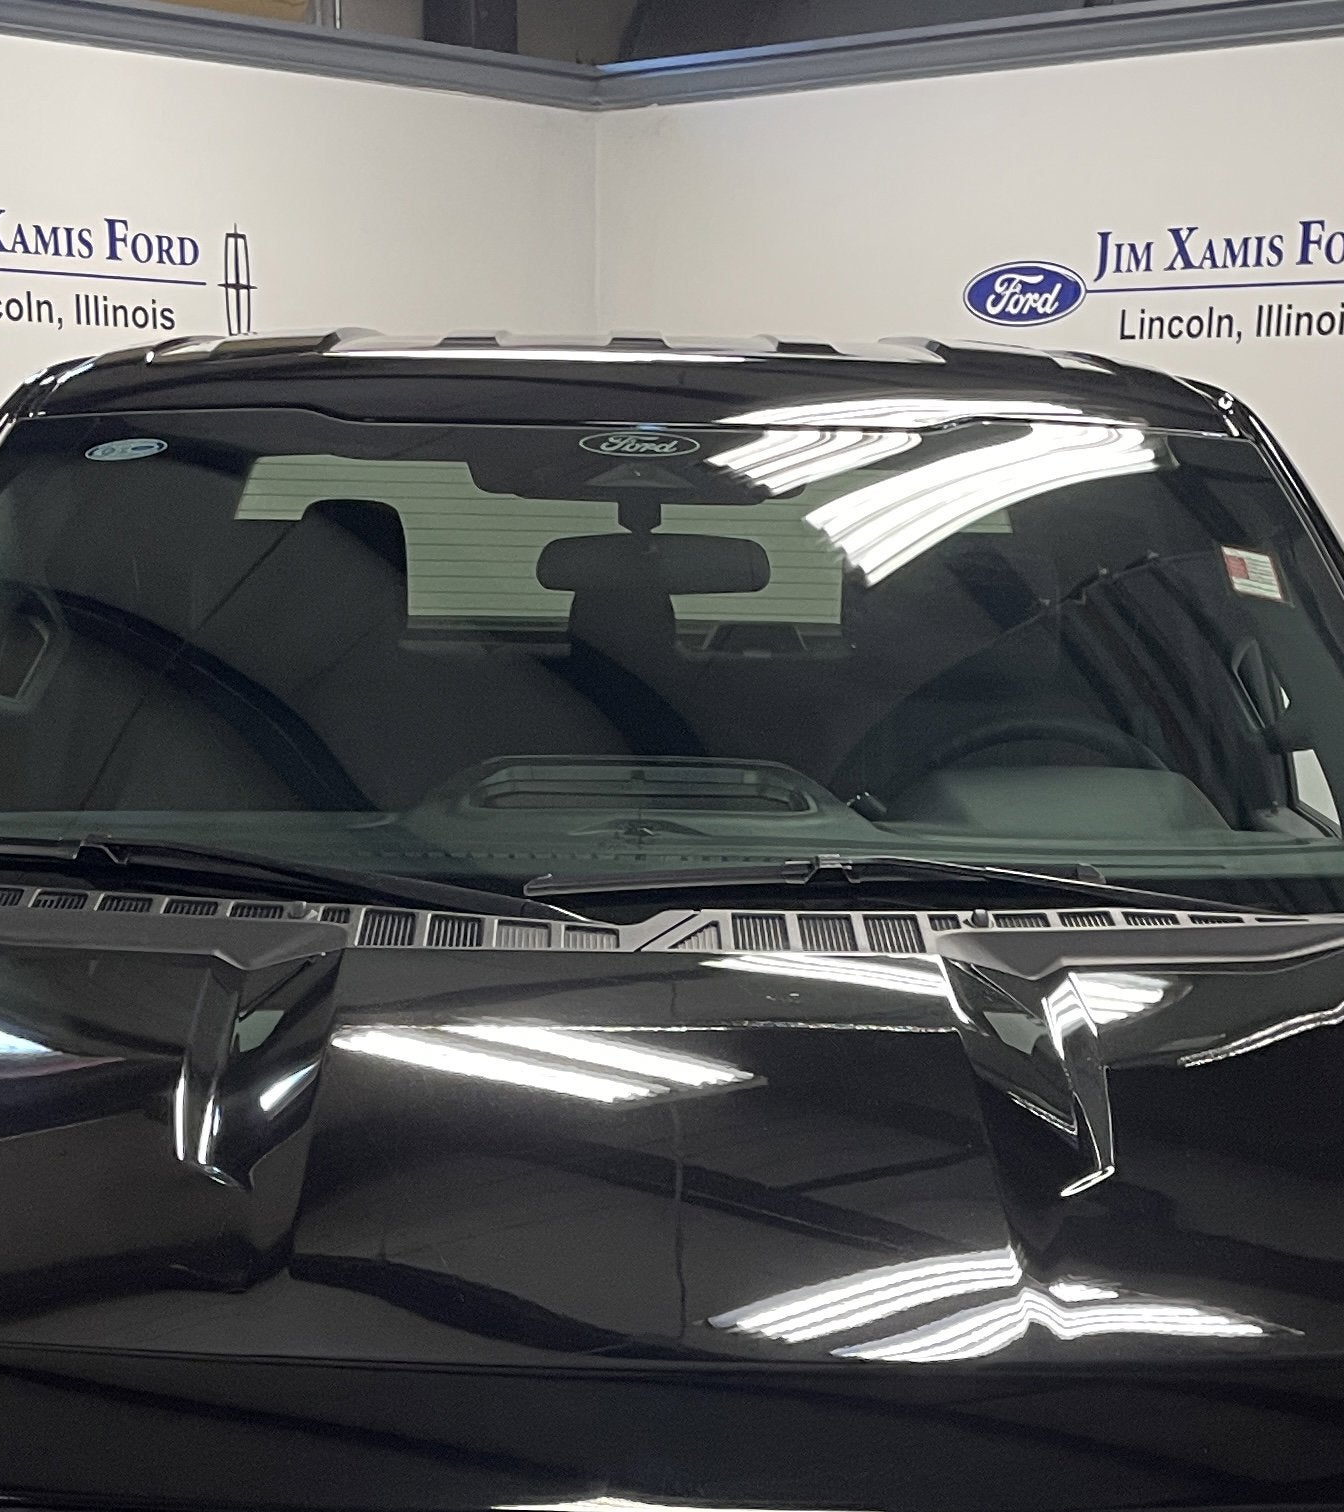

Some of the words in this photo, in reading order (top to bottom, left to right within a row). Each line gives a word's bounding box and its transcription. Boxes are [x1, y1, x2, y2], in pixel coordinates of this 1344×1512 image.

[104, 217, 200, 267] FORD
[1093, 231, 1154, 283] JIM
[1163, 226, 1284, 272] XAMIS
[74, 293, 176, 331] Illinois
[985, 274, 1060, 316] Ford
[1119, 306, 1242, 345] Lincoln,
[600, 433, 679, 453] Ford
